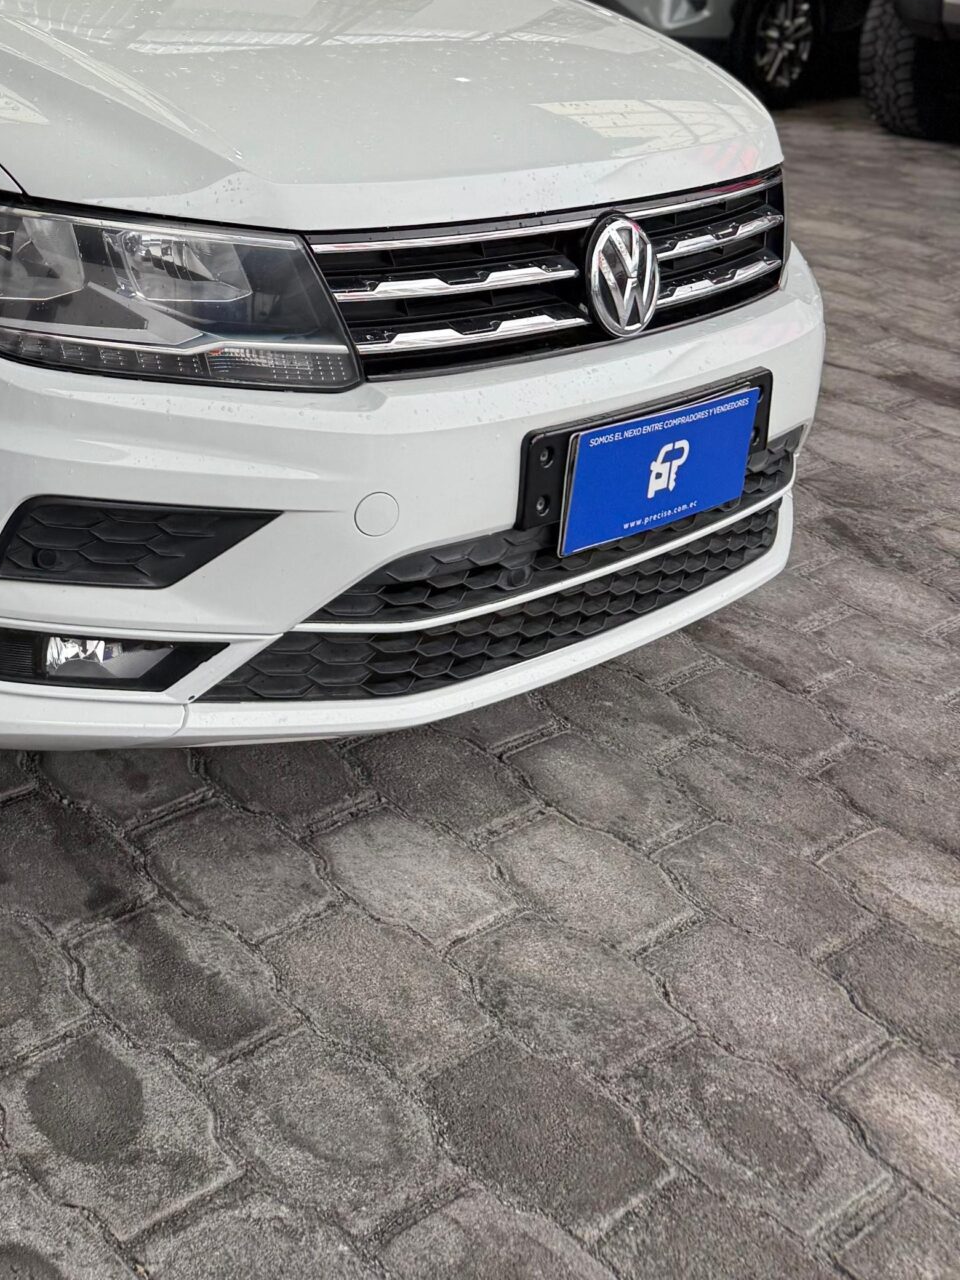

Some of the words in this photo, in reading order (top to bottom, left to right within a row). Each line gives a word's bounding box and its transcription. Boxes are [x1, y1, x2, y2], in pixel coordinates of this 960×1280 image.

[589, 433, 614, 448] SOMOS
[614, 431, 623, 441] EL
[624, 427, 641, 439] NEXO
[642, 422, 664, 435] ENTRE
[663, 409, 709, 430] COMPRADORES
[708, 408, 714, 417] Y
[713, 397, 750, 416] VENDEDORES
